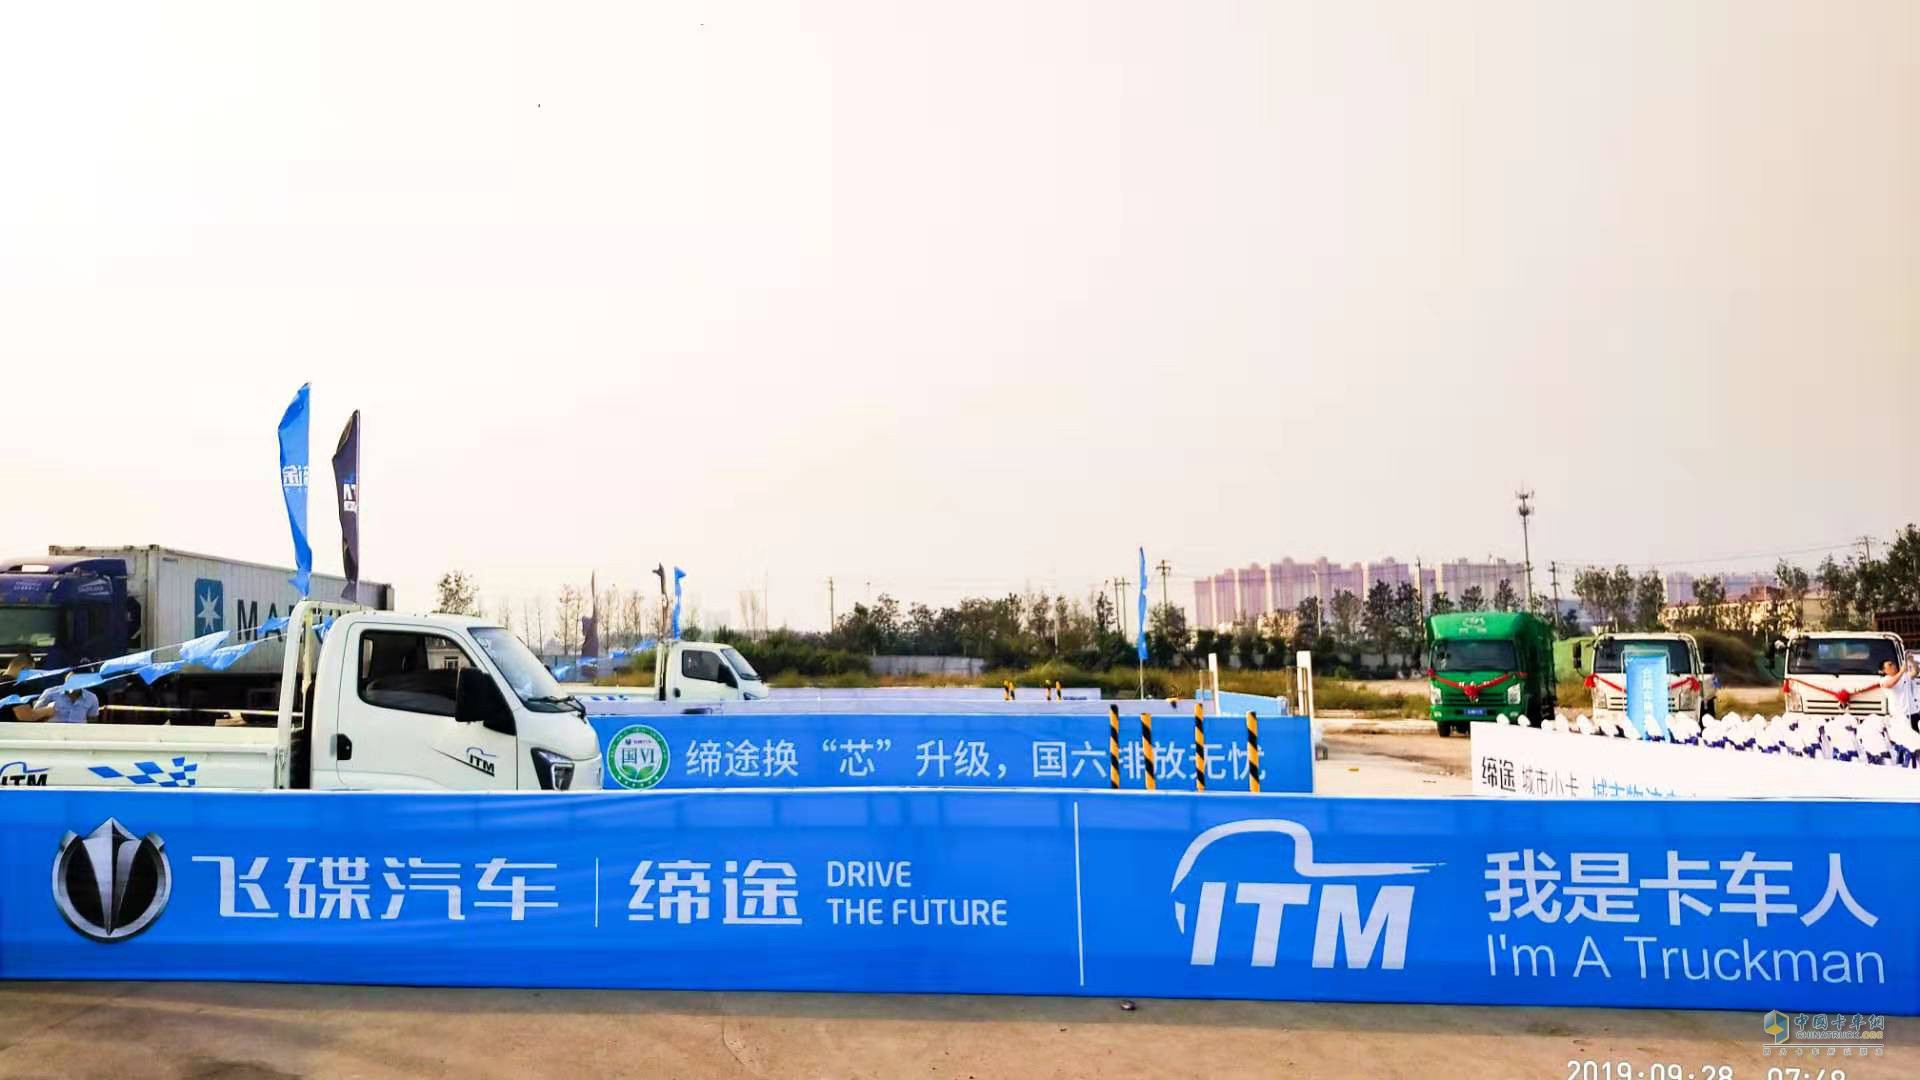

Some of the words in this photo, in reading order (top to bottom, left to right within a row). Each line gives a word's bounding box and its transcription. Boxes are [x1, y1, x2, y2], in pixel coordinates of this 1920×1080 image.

[1, 774, 48, 786] ITM
[469, 754, 495, 773] ITM
[1482, 756, 1516, 792] 缔途
[192, 855, 560, 921] 飞碟汽车
[628, 860, 803, 925] 缔途
[826, 861, 912, 888] DRIVE
[1484, 848, 1880, 928] 我是卡车人
[826, 898, 884, 926] THE
[892, 898, 1009, 927] FUTURE
[1190, 881, 1416, 970] ITM
[1487, 933, 1557, 978] I'm
[1572, 935, 1612, 979] A
[1623, 935, 1886, 985] Truckman
